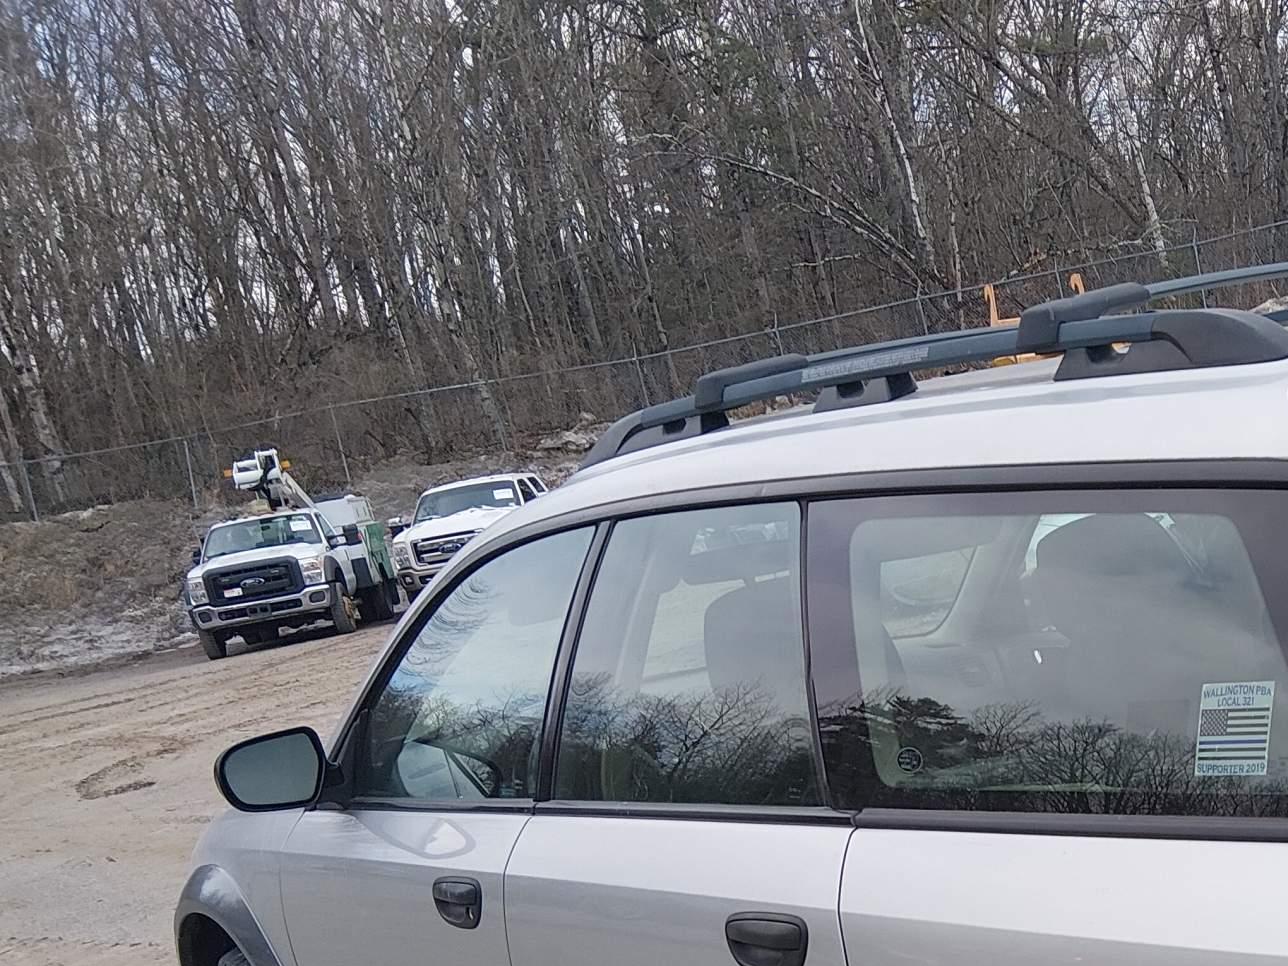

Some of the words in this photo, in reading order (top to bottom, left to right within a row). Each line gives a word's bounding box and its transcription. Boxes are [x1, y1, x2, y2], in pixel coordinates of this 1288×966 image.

[1203, 684, 1255, 698] WALLINGTON
[1255, 685, 1272, 696] PBA
[1217, 697, 1240, 707] LOCAL
[1242, 696, 1255, 706] 321
[1197, 763, 1245, 774] SUPPORTER
[1246, 762, 1266, 773] 2019
